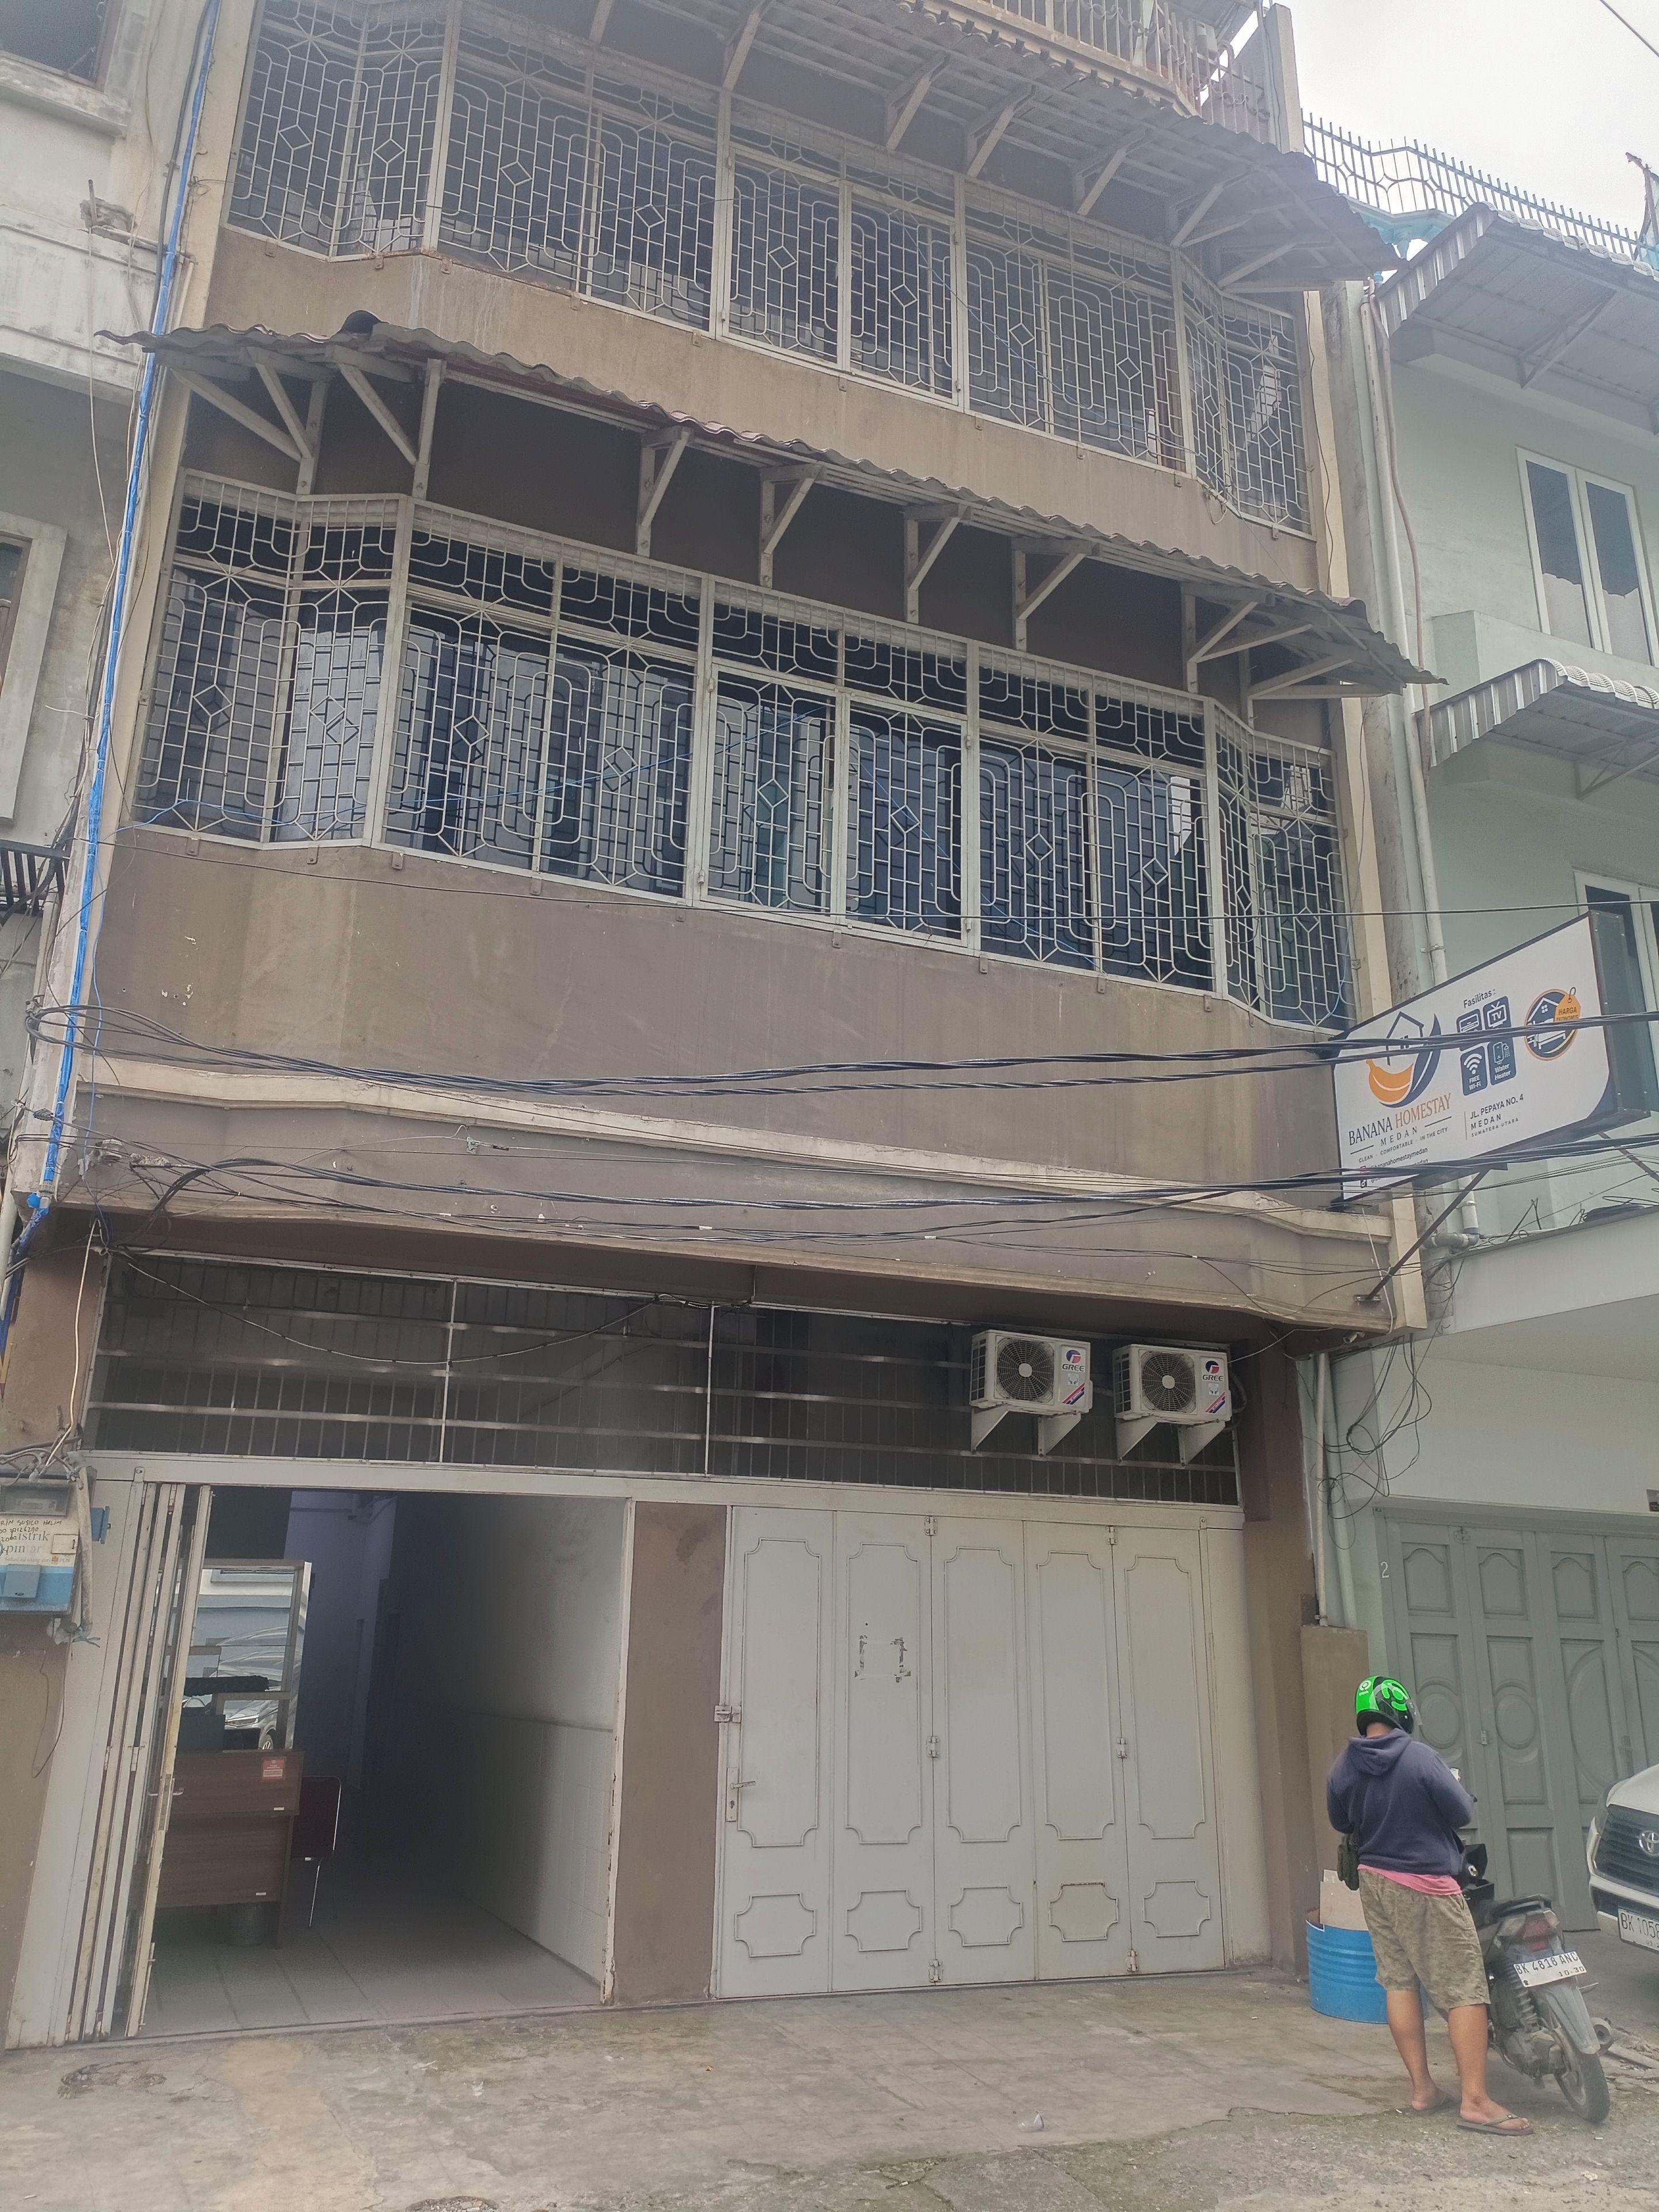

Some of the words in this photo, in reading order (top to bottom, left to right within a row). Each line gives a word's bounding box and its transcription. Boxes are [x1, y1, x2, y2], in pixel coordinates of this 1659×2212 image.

[1491, 1010, 1502, 1021] TV
[1558, 1006, 1577, 1016] HARGA
[1494, 1063, 1510, 1073] Water
[1494, 1070, 1511, 1080] Heater
[1469, 1075, 1480, 1084] FREE
[1480, 1101, 1505, 1115] PEPAYA
[1506, 1097, 1518, 1107] NO.
[1349, 1116, 1393, 1145] BANANA
[1395, 1093, 1450, 1128] HOMESTAY
[1471, 1113, 1501, 1130] MEDAN
[1471, 1124, 1499, 1137] SUMATERA
[1501, 1118, 1518, 1127] UTARA
[1381, 1126, 1418, 1146] MEDAN
[1358, 1154, 1373, 1163] CLEAN
[1380, 1139, 1413, 1156] COMFORTABLE
[1437, 1127, 1448, 1135] CITY
[1062, 1363, 1085, 1372] GREE
[1202, 1374, 1224, 1382] GREE
[1380, 1561, 1389, 1578] 2
[1620, 1912, 1635, 1932] BK
[1515, 1963, 1530, 1975] BK
[1532, 1956, 1558, 1971] 4818
[1558, 1952, 1578, 1965] ANC
